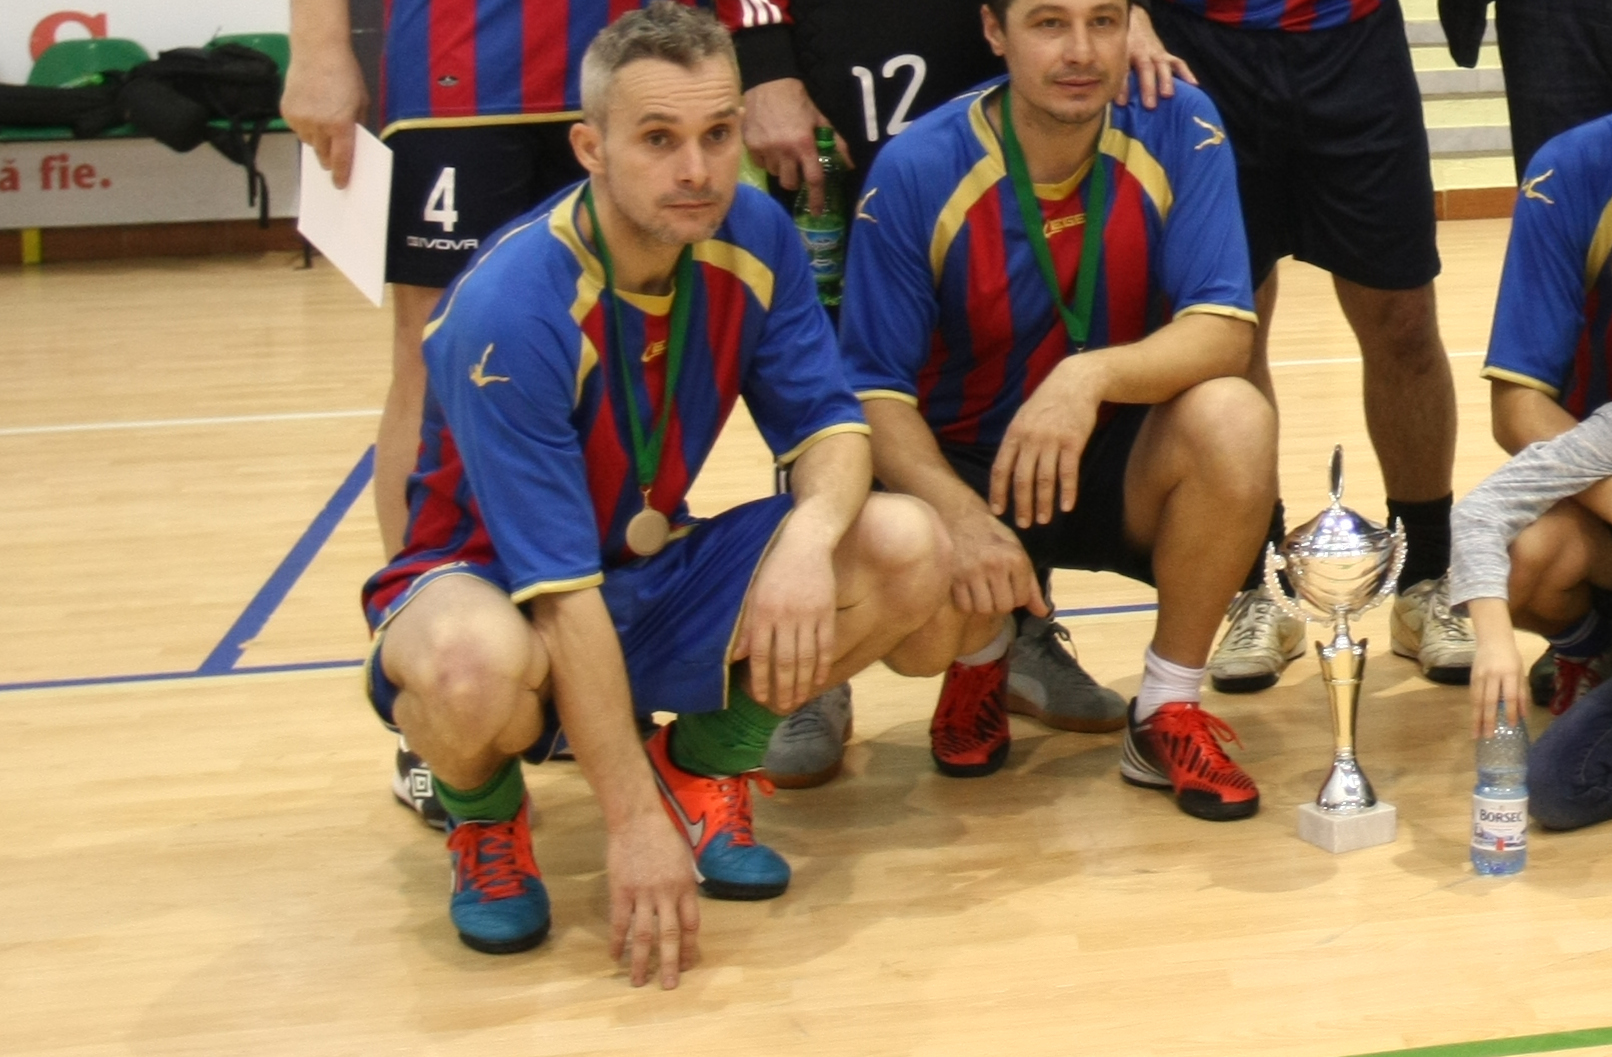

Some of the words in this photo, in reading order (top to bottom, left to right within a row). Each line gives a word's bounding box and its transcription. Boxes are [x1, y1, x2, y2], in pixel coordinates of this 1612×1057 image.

[852, 53, 927, 142] 12
[41, 153, 112, 191] fie.
[424, 166, 458, 232] 4
[1480, 808, 1523, 823] BORSEC
